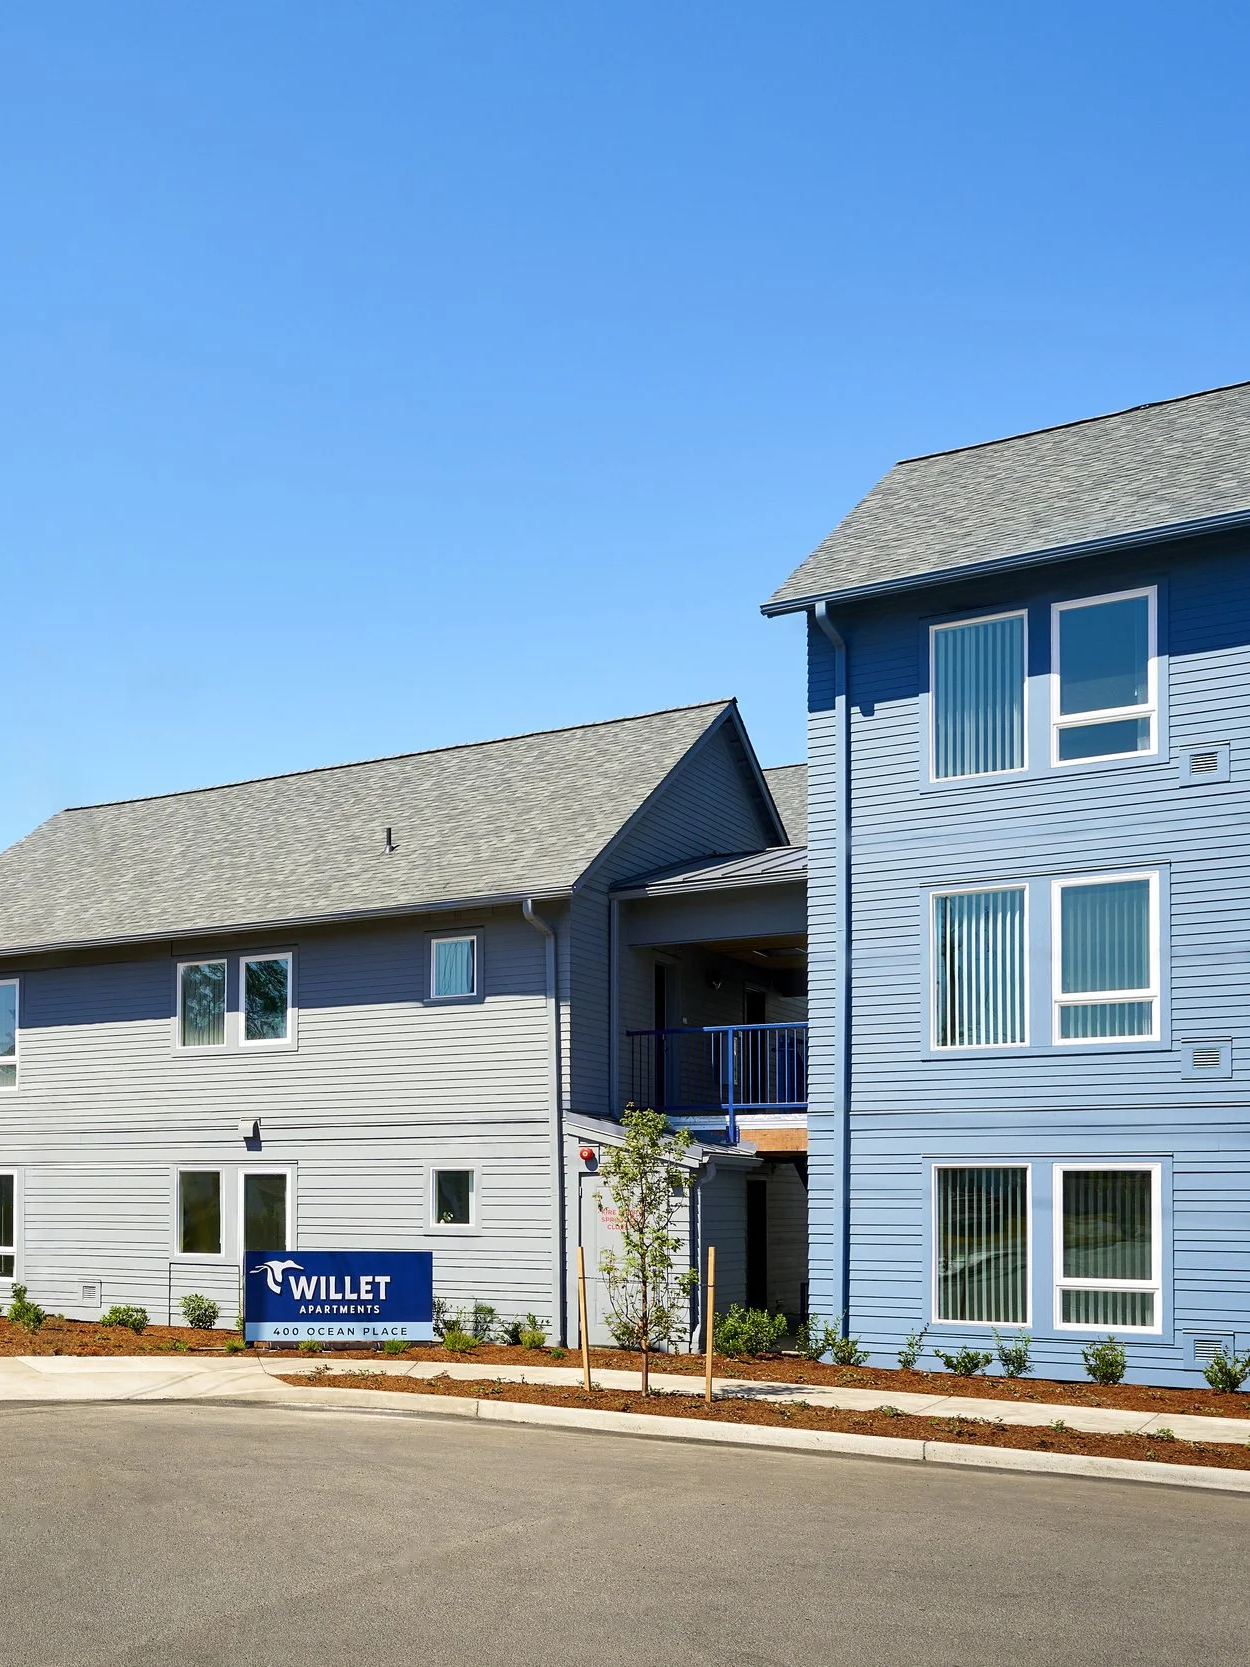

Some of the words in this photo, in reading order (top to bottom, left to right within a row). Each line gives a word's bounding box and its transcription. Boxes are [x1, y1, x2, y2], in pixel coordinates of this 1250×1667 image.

[288, 1276, 391, 1300] WILLET
[299, 1305, 380, 1314] APARTMENTS
[273, 1327, 300, 1336] 400
[306, 1327, 356, 1336] OCEAN
[363, 1327, 408, 1336] PLACE
